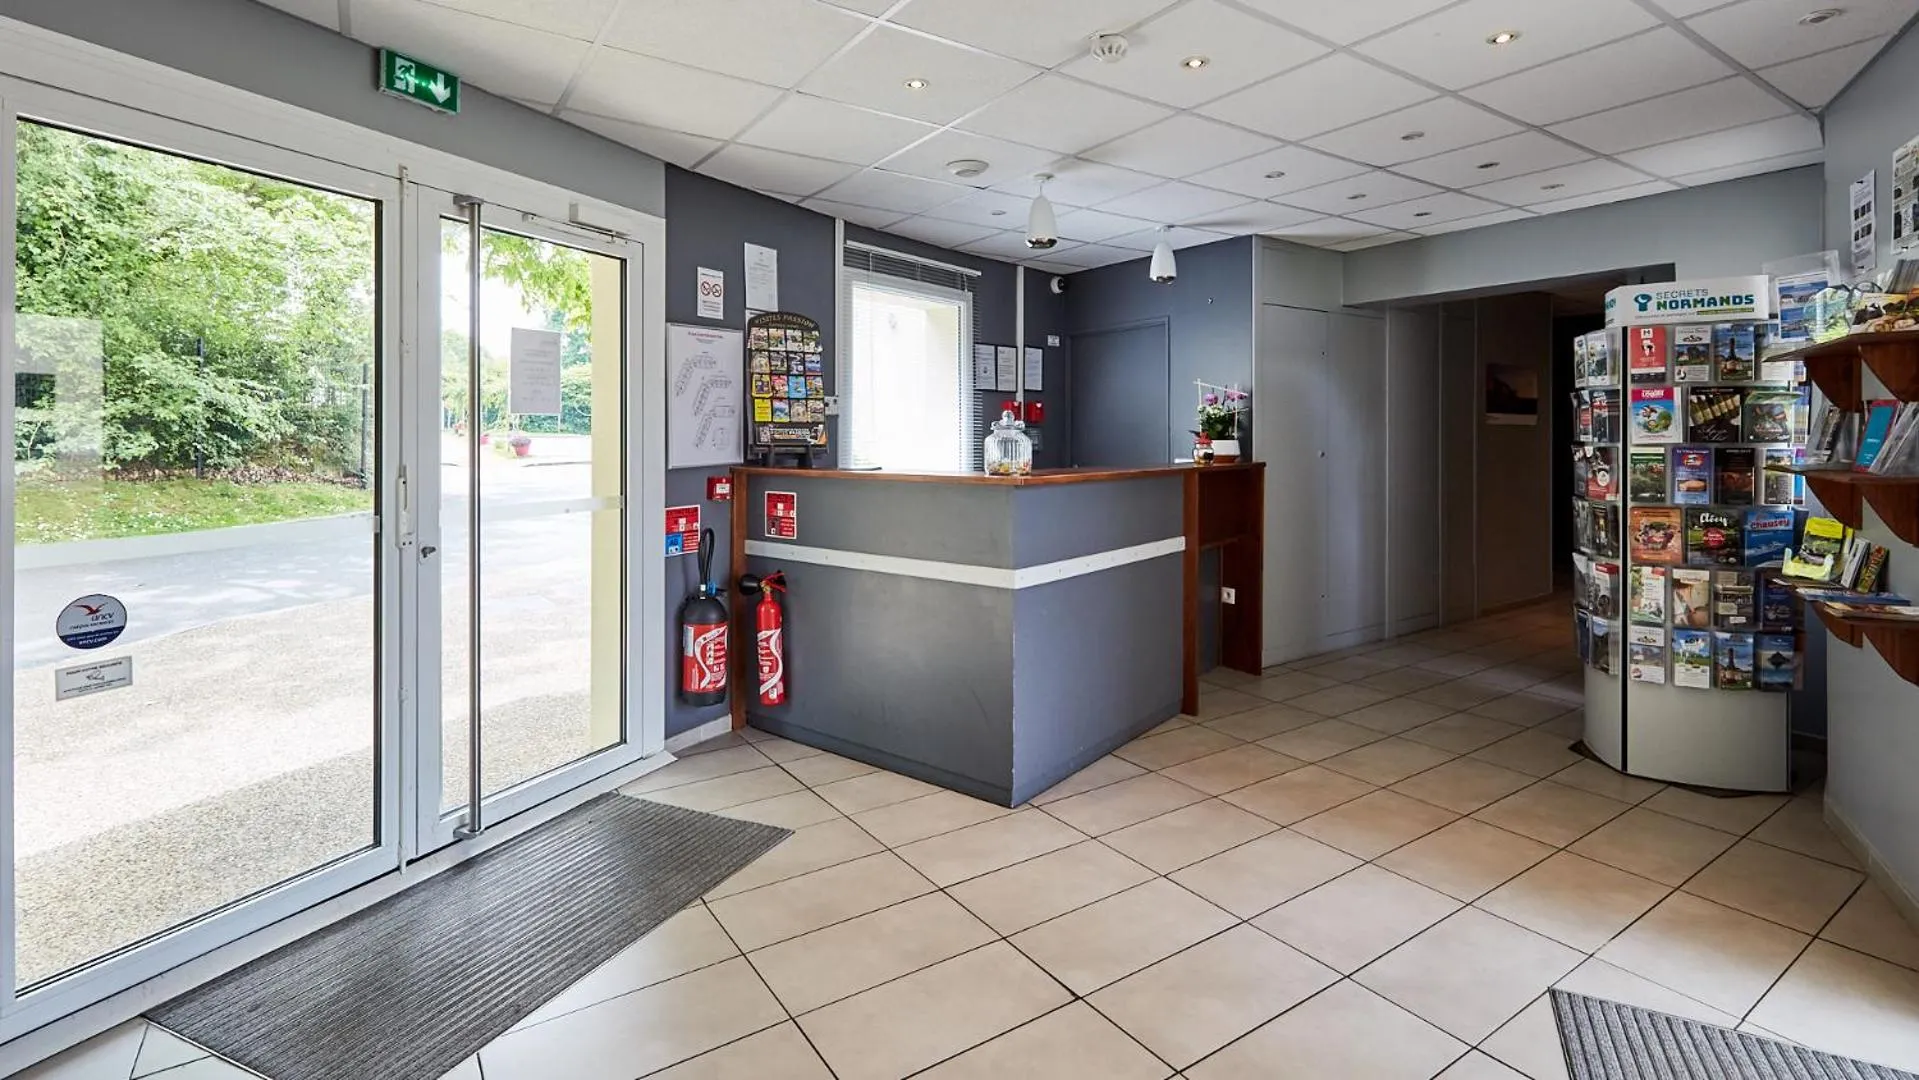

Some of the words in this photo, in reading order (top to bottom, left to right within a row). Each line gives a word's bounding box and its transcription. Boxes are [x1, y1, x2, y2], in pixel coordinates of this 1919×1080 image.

[1656, 288, 1709, 300] SECRETS
[1655, 294, 1755, 311] NORMANDS
[783, 314, 815, 328] PASSION
